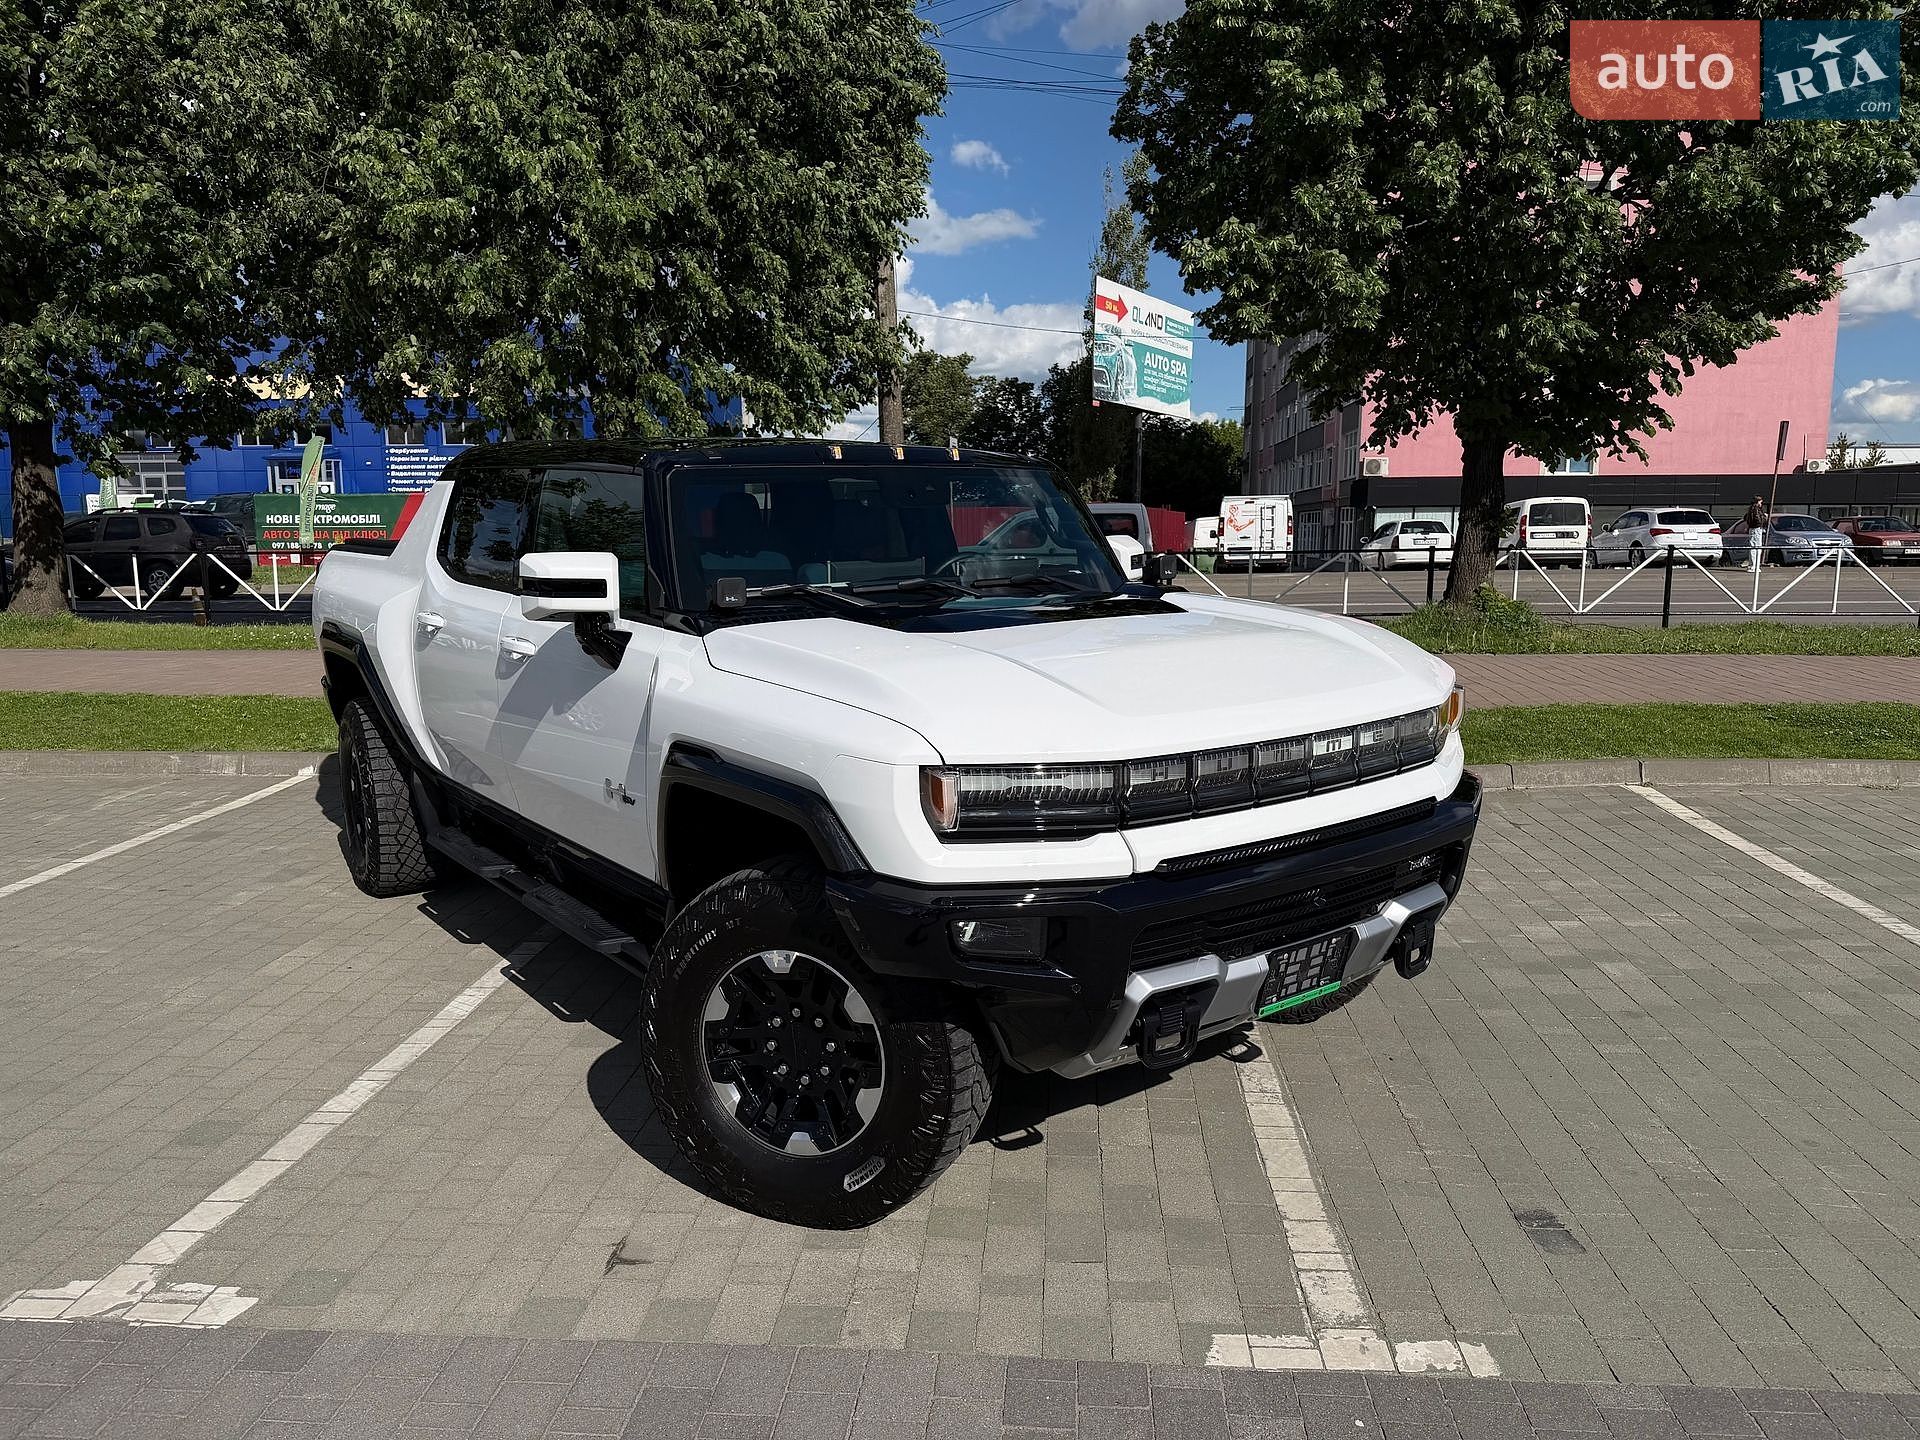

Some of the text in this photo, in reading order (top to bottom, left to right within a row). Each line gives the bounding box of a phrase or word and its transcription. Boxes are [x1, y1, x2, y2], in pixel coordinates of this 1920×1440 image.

[1105, 300, 1112, 310] 50
[1144, 352, 1169, 372] AUTO
[1171, 360, 1187, 377] SPA
[389, 455, 419, 463] Кераміка
[266, 514, 380, 524] НОВІ ЕКТРОМОБІЛІ
[263, 530, 291, 539] АВТО
[353, 530, 387, 539] КЛЮЧ
[847, 1160, 882, 1190] DURAWALL
